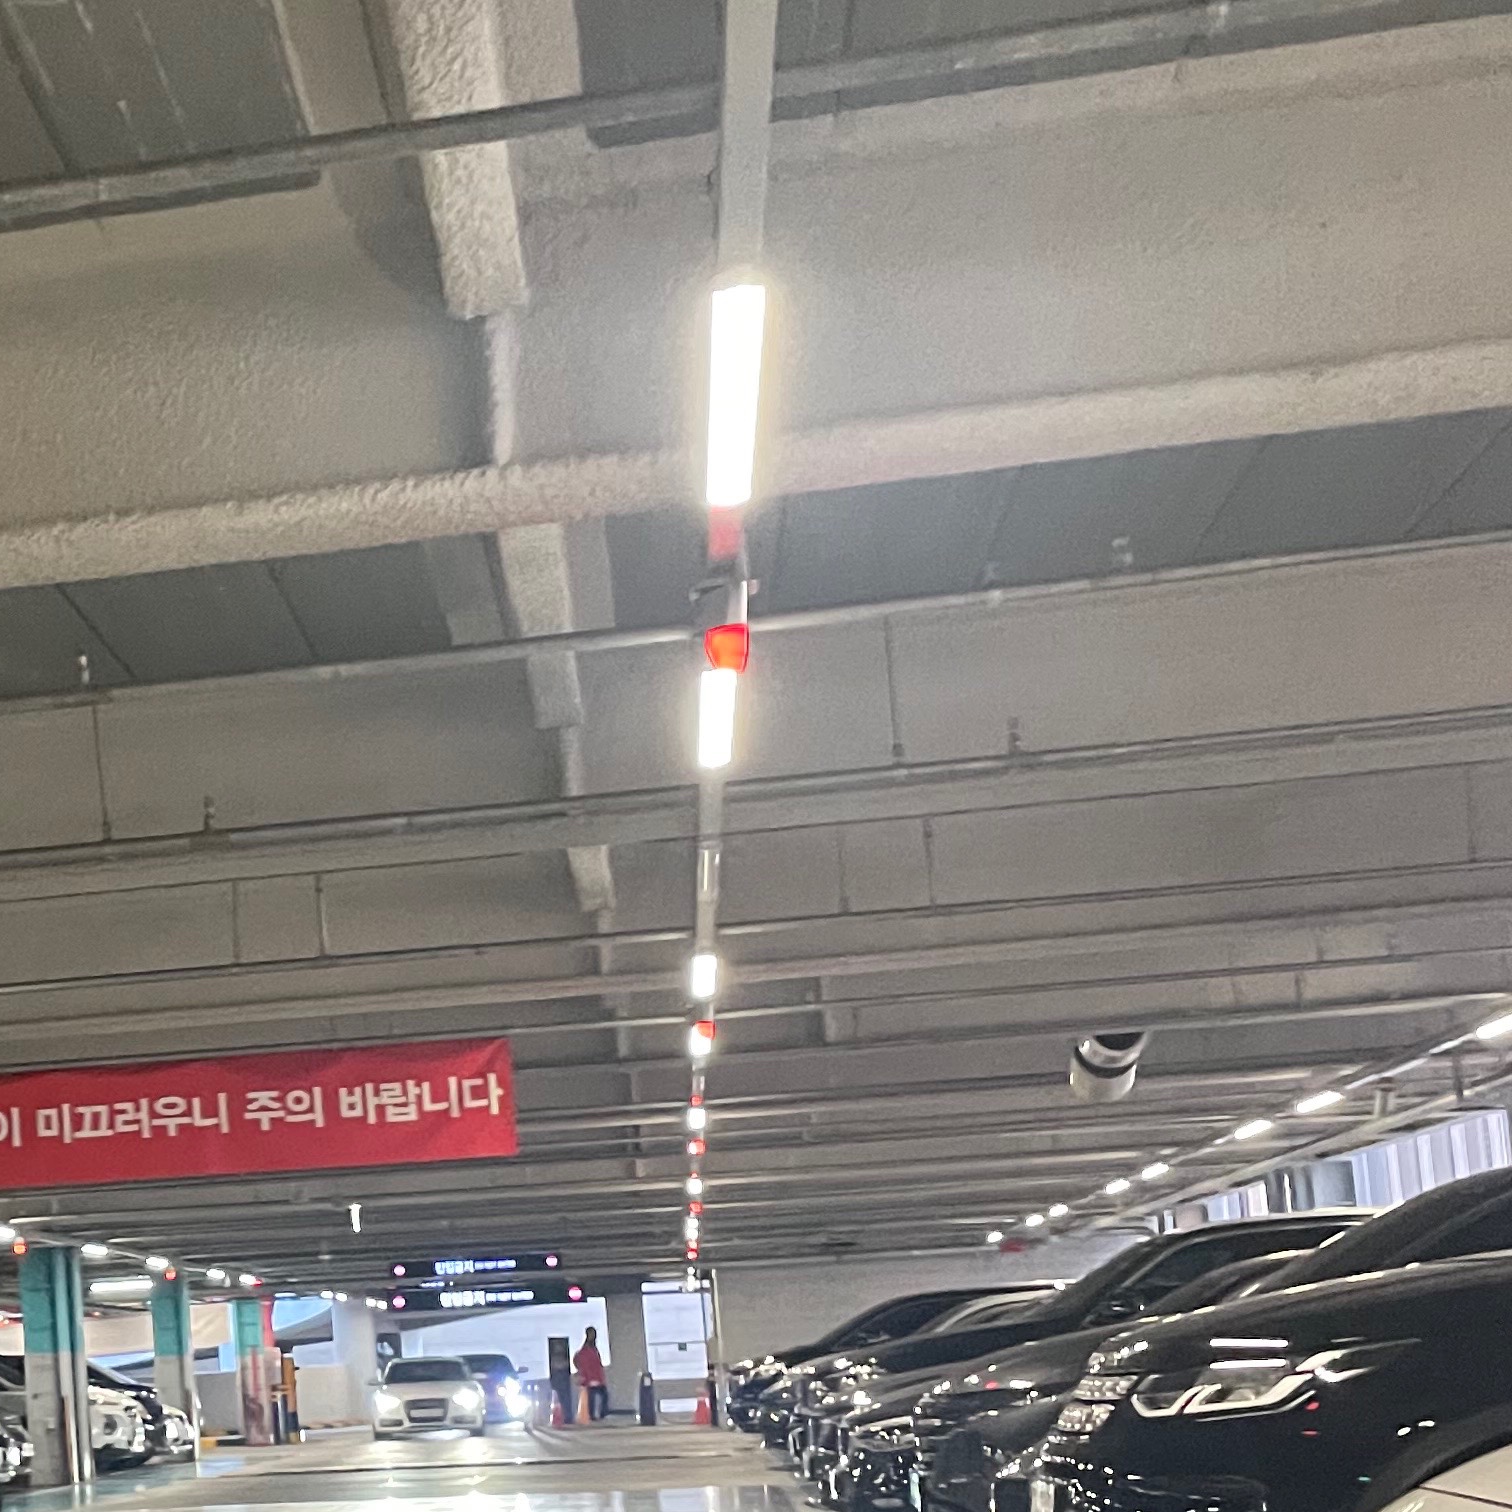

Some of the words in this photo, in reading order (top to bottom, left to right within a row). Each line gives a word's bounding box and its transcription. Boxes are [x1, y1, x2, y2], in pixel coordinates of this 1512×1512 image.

[36, 1092, 230, 1144] 미끄러우니
[243, 1086, 326, 1132] 주의
[339, 1073, 505, 1125] 바랍니다
